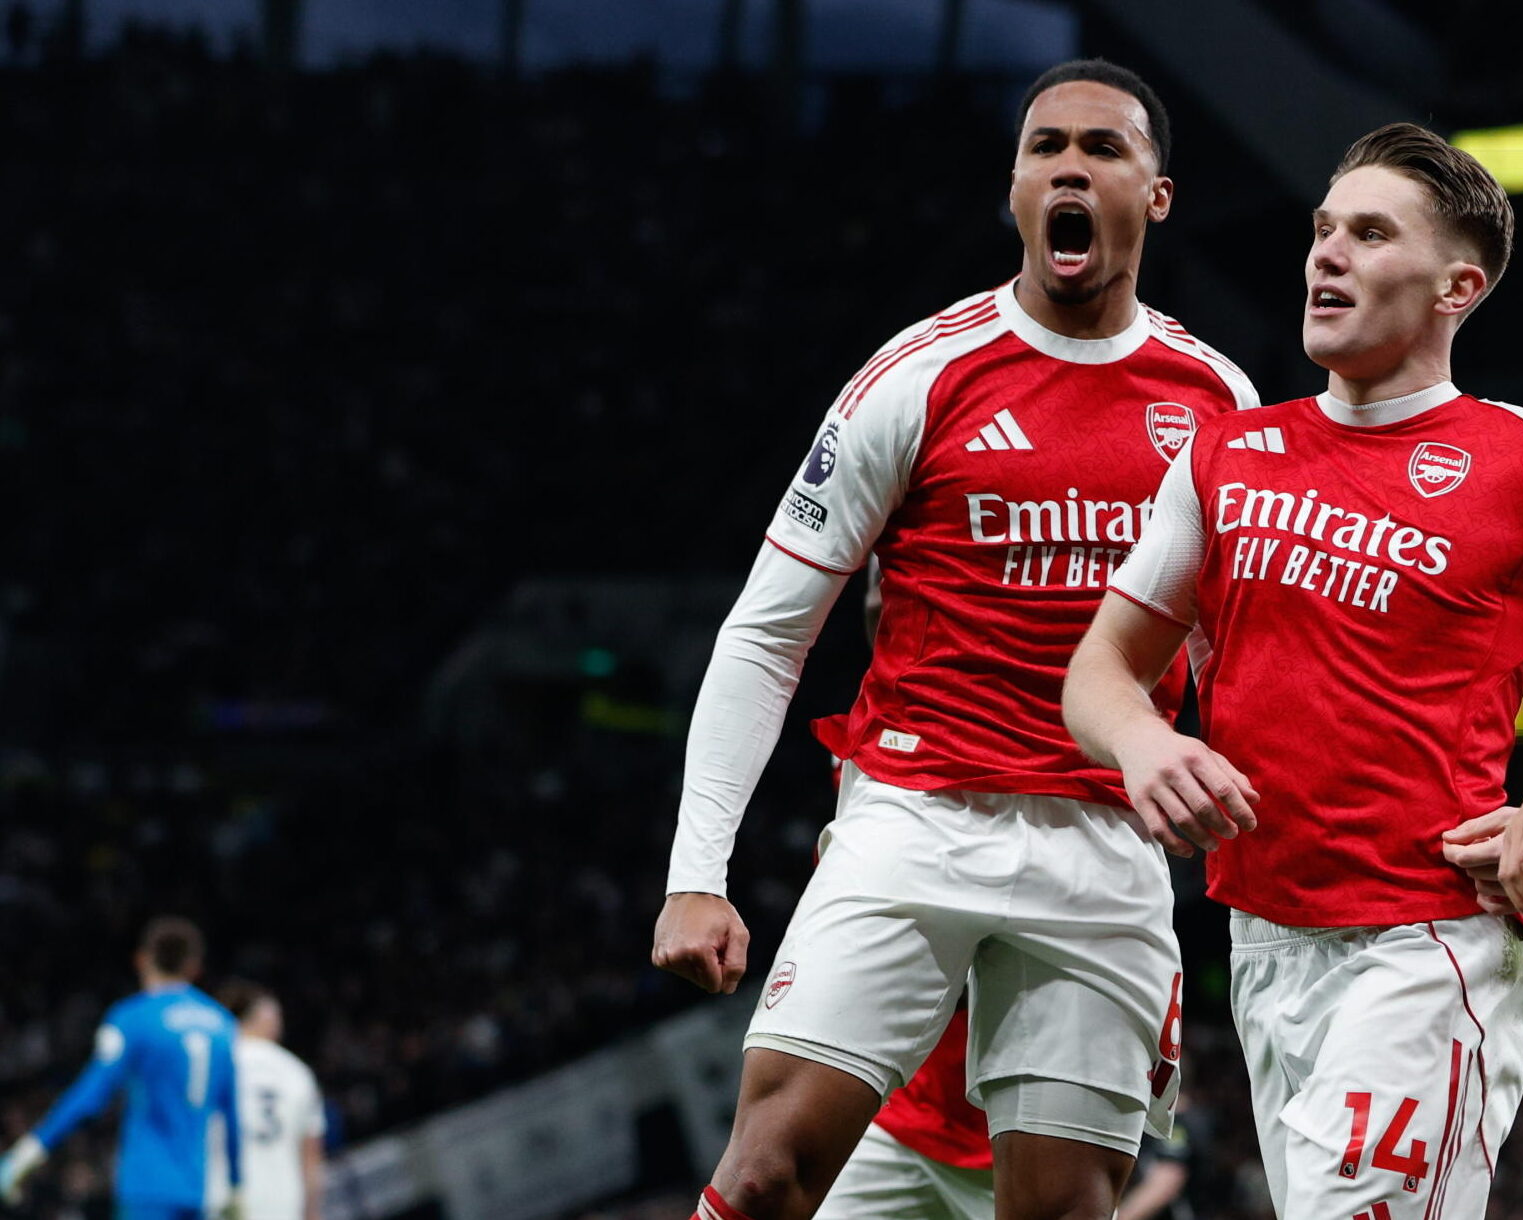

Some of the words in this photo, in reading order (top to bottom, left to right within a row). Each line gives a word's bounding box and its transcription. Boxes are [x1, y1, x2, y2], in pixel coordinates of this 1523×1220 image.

[1420, 451, 1463, 468] Arsenal
[1002, 545, 1057, 587] FLY
[1065, 546, 1132, 588] BET
[1216, 482, 1452, 576] Emirates
[1232, 536, 1281, 581] FLY
[1280, 544, 1399, 613] BETTER
[1158, 972, 1182, 1062] 6
[182, 1028, 212, 1111] 1
[1338, 1091, 1430, 1194] 14
